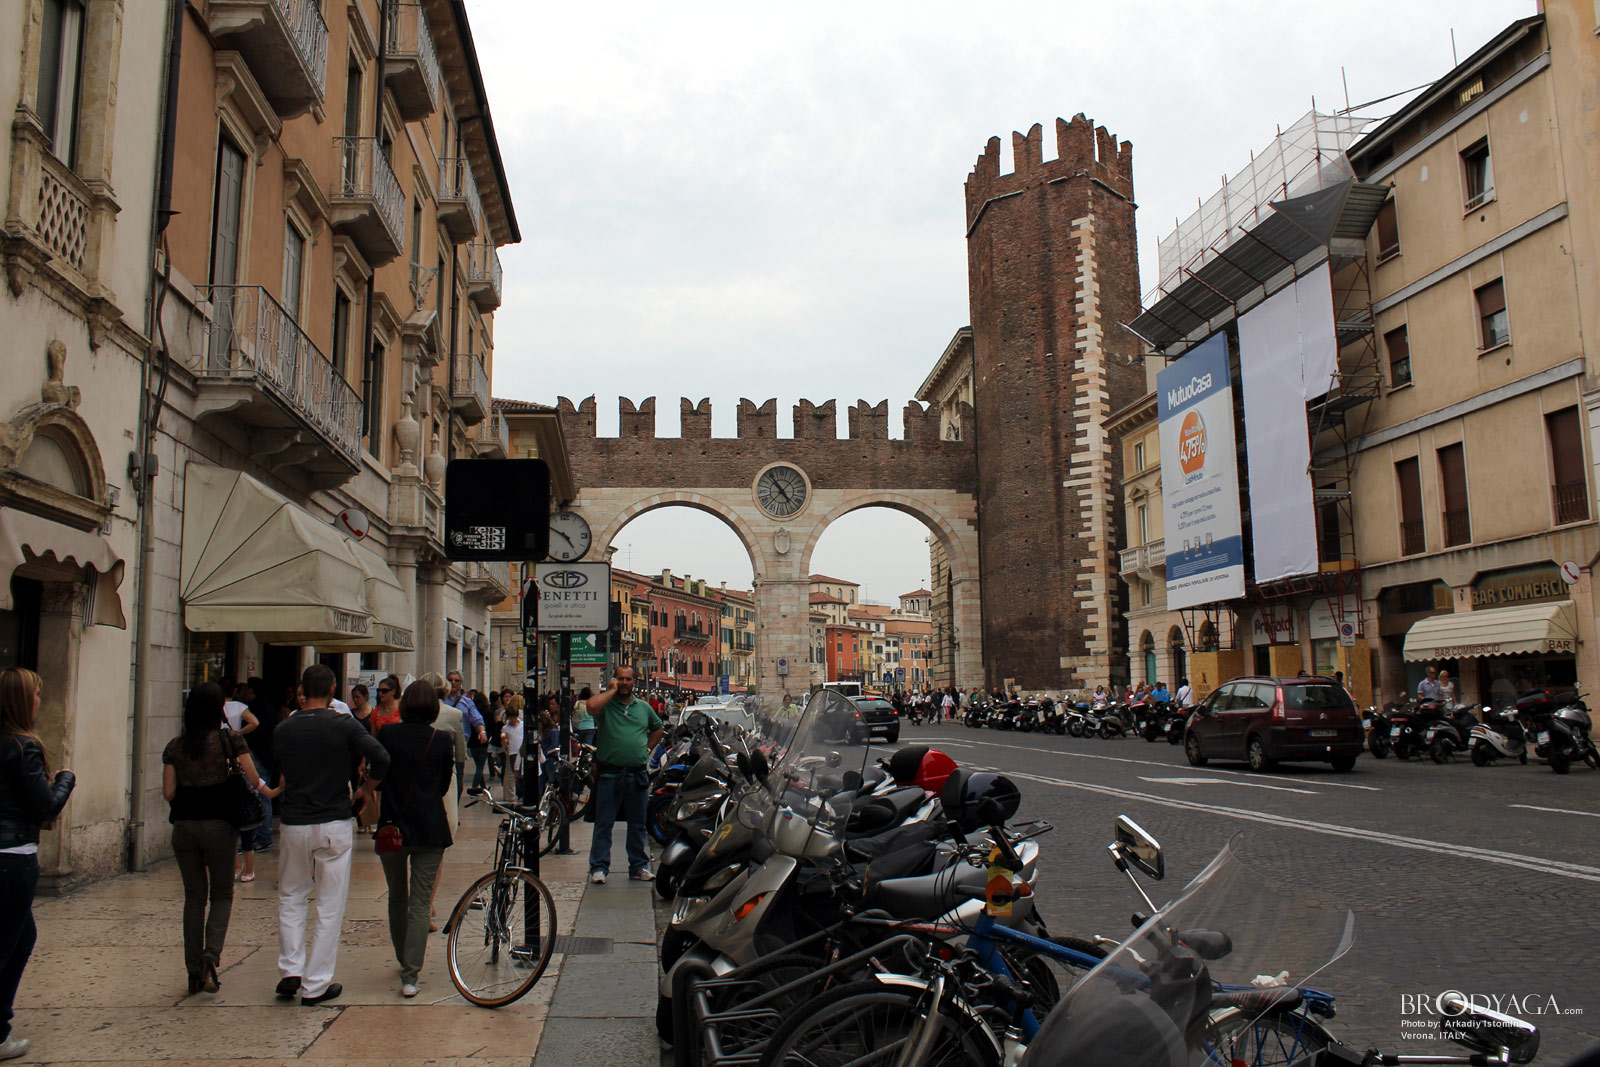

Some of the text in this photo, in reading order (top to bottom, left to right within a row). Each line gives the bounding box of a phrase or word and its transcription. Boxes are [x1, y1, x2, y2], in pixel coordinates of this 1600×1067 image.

[1168, 373, 1212, 410] MutuoCasa
[1180, 435, 1206, 464] 4,75%
[1471, 588, 1496, 604] BAR
[1434, 643, 1500, 657] BAR COMMERCIO
[1548, 640, 1570, 650] BAR
